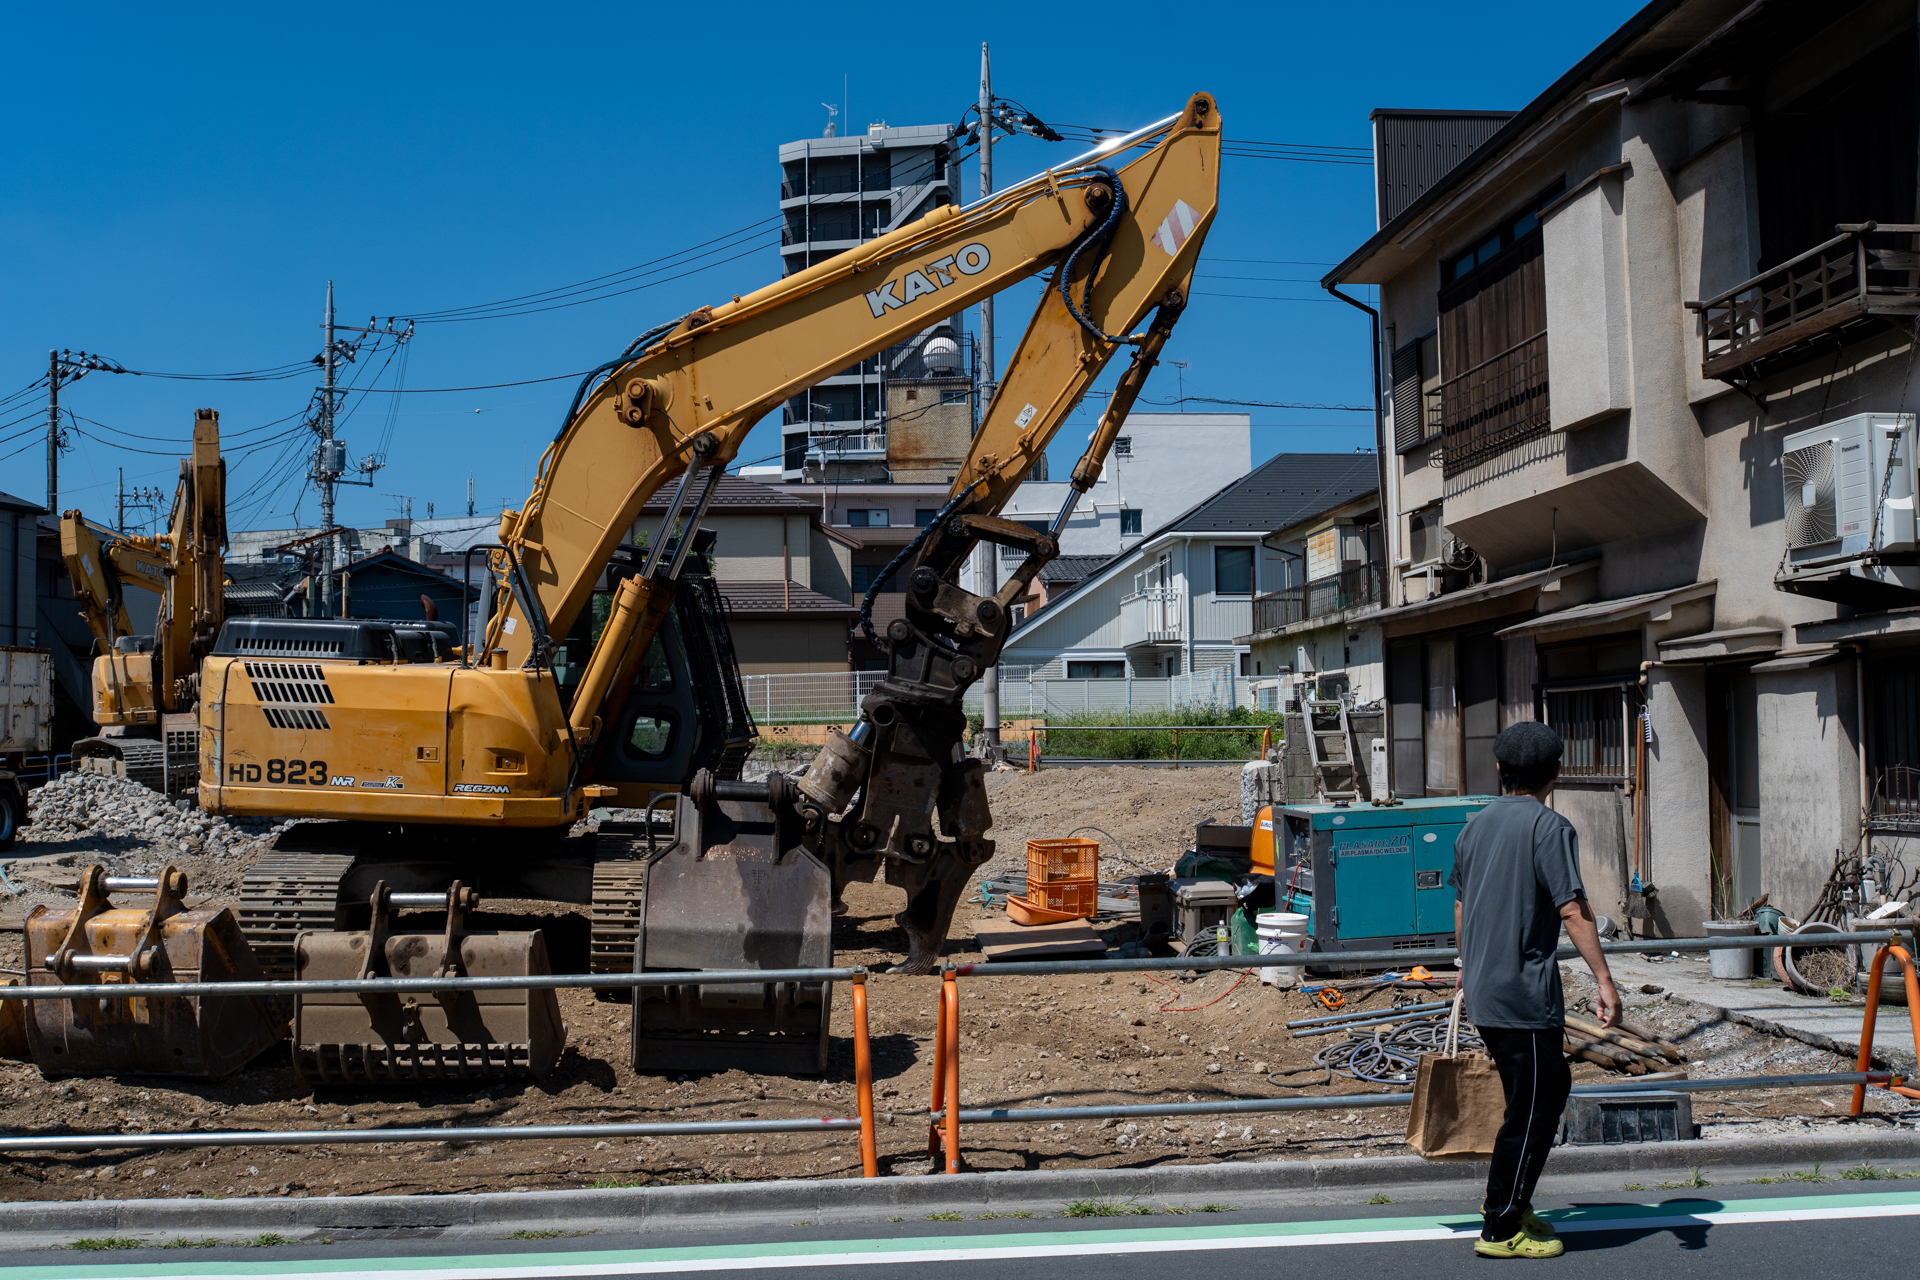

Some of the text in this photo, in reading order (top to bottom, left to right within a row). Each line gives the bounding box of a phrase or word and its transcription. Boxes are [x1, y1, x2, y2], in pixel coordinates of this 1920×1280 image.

[864, 242, 991, 319] KATO
[229, 763, 262, 783] HD
[266, 759, 328, 785] 823
[330, 776, 355, 788] MR
[453, 783, 511, 794] REGZAM
[1389, 835, 1408, 847] 70
[1384, 846, 1408, 854] WELDER
